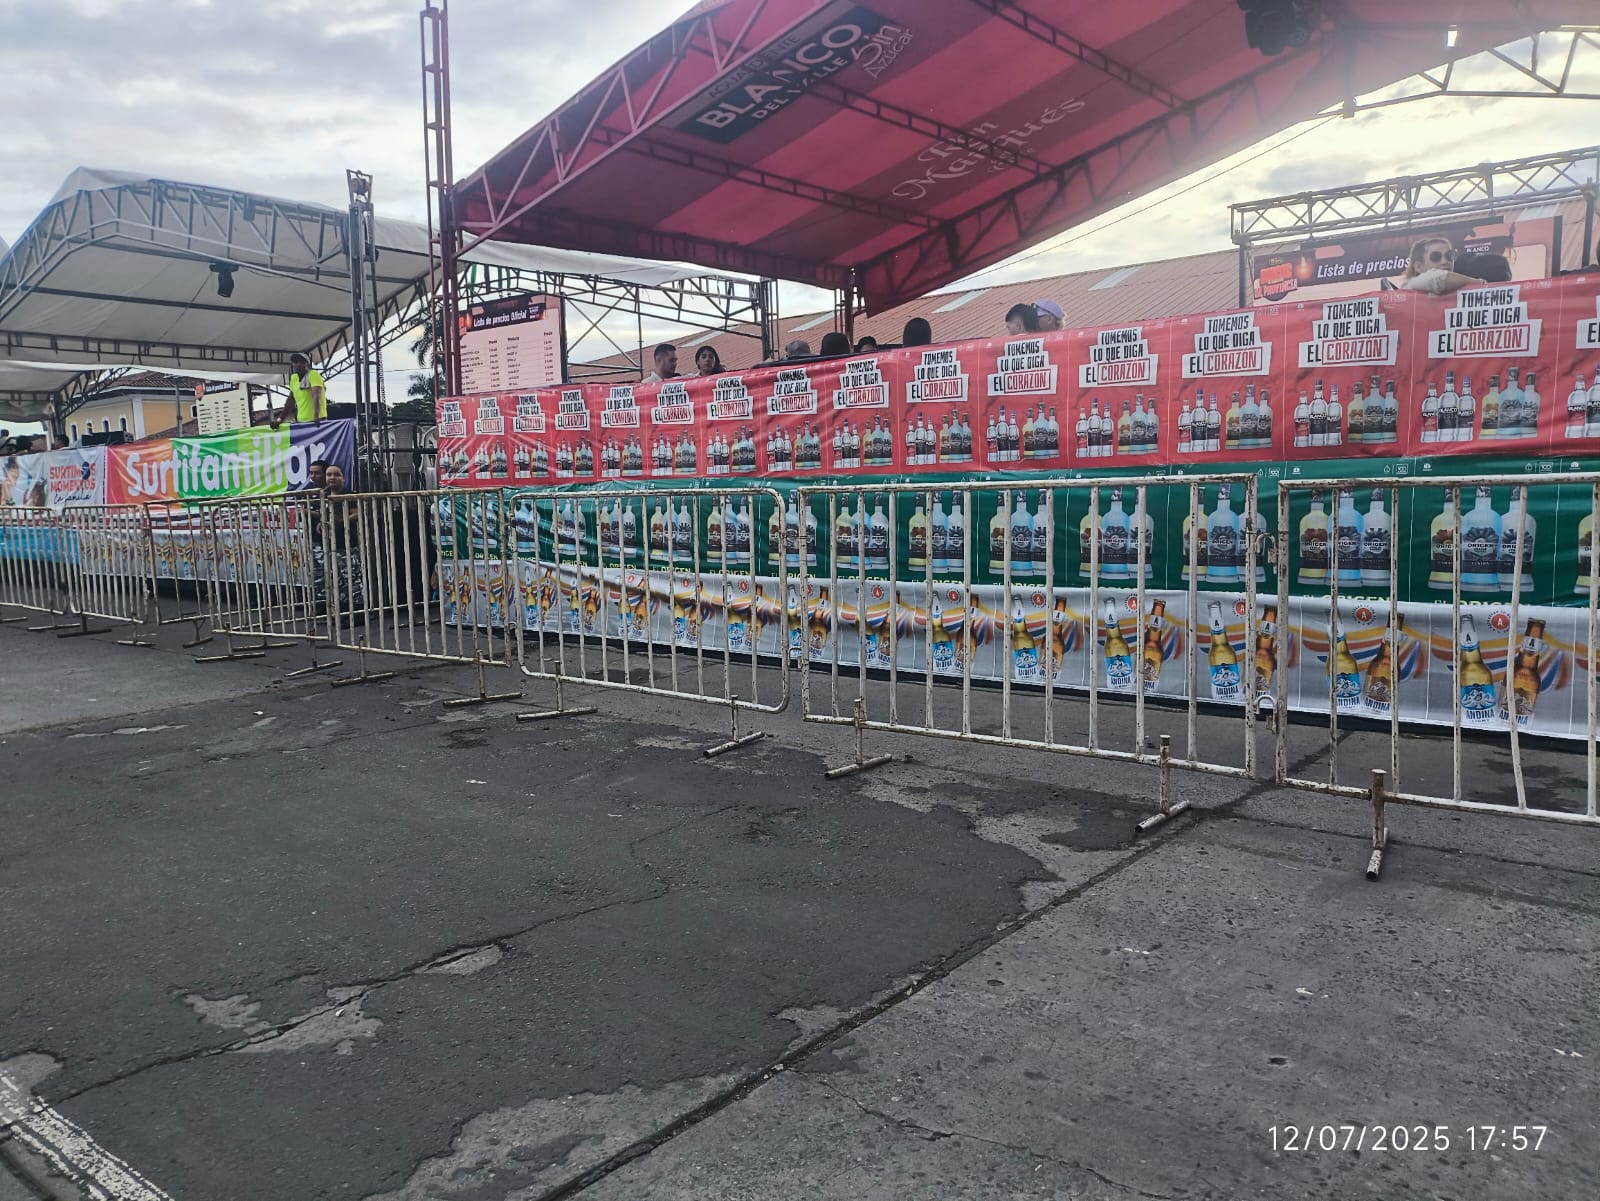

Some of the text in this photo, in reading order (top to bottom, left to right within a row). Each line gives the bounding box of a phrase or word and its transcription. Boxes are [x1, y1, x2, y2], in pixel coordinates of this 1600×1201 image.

[1317, 257, 1410, 278] Lista de precios
[1461, 289, 1513, 308] TOMEMOS
[1327, 301, 1373, 320] TOMEMOS
[1450, 306, 1521, 328] LO QUE DIGA
[1208, 316, 1249, 333] TOMEMOS
[1318, 318, 1380, 340] LO QUE DIGA
[1101, 329, 1138, 345] TOMEMOS
[1199, 332, 1255, 351] LO QUE DIGA
[1438, 325, 1522, 353] EL CORAZÓN
[1007, 341, 1040, 356] TOMEMOS
[1094, 344, 1144, 363] LO QUE DIGA
[1307, 337, 1382, 362] EL CORAZÓN
[924, 351, 953, 366] TOMEMOS
[1001, 355, 1045, 372] LO QUE DIGA
[1190, 349, 1257, 373] EL CORAZÓN
[917, 365, 957, 381] LO QUE DIGA
[1086, 361, 1145, 383] EL CORAZÓN
[912, 385, 920, 399] EL
[994, 376, 1004, 391] EL
[49, 462, 96, 479] SURTIMS
[127, 433, 326, 497] Surtifamiliar
[1216, 685, 1239, 695] ANDINA
[1338, 696, 1360, 707] NDINA
[1365, 697, 1391, 711] ANDINA
[1466, 709, 1494, 720] ANDINA
[1499, 710, 1529, 725] ANINA
